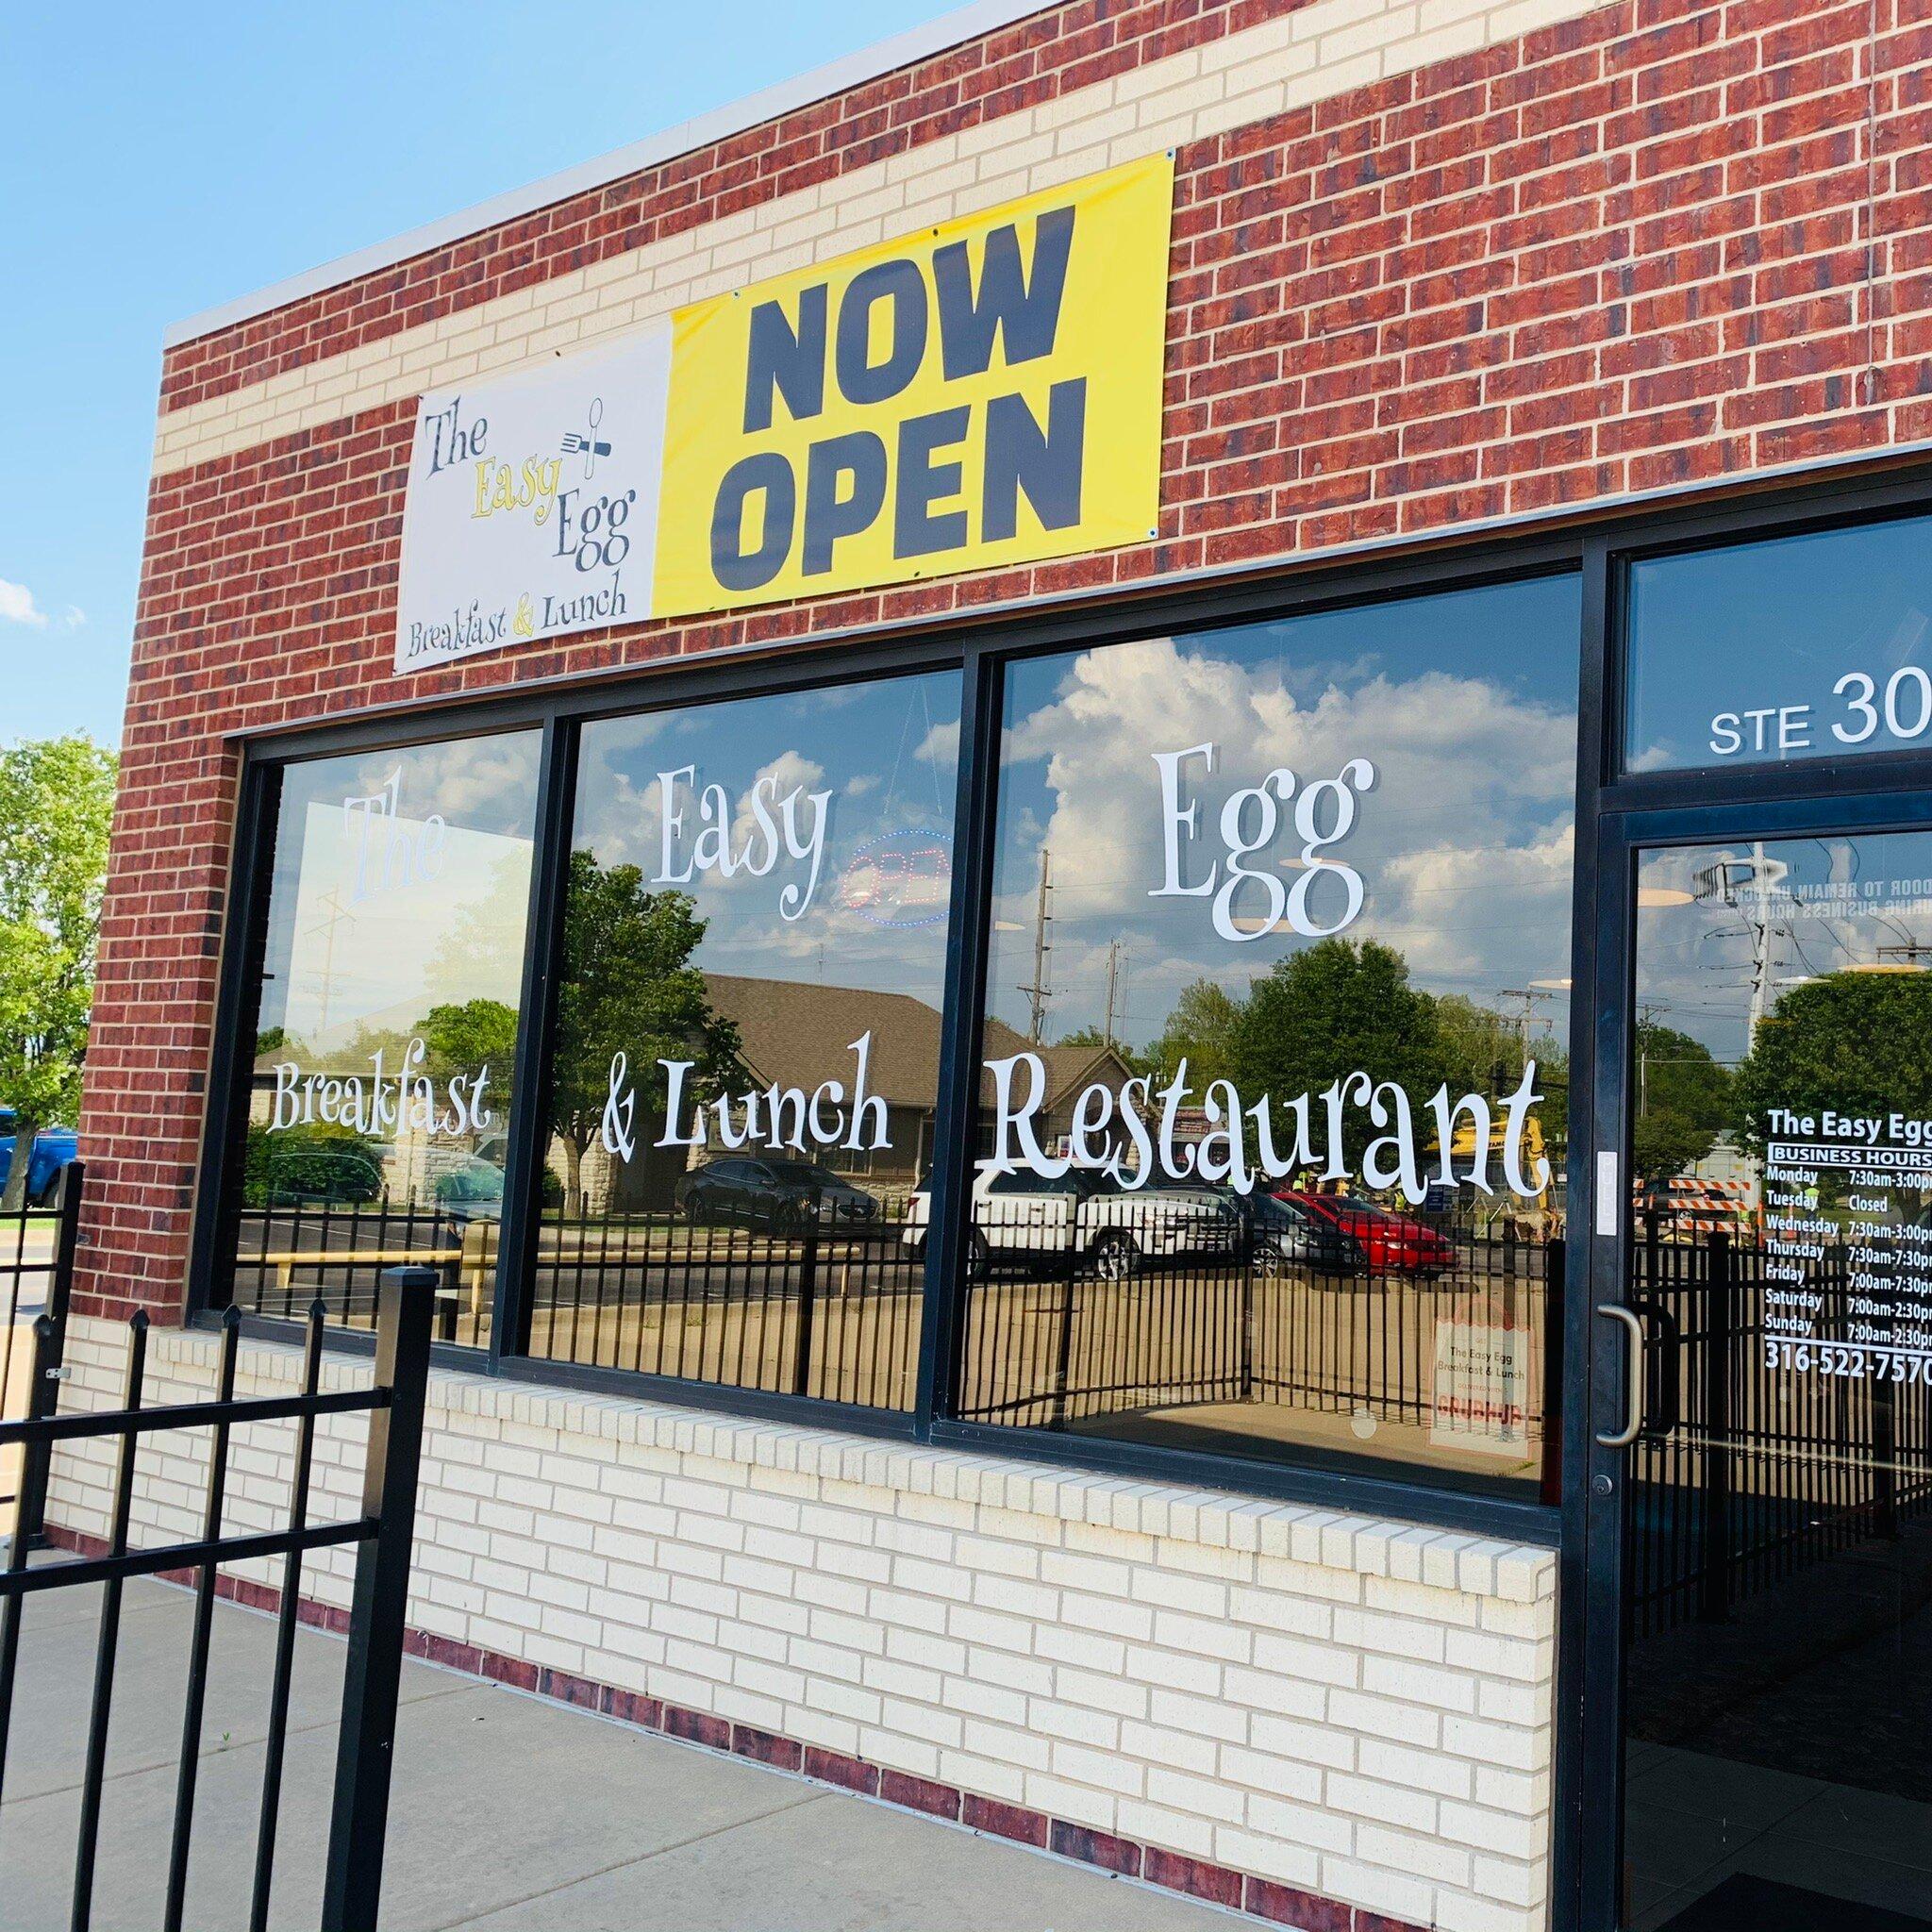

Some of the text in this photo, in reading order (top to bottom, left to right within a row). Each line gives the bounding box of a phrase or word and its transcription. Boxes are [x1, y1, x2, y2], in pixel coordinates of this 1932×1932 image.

[742, 204, 1076, 434] NOW
[425, 393, 488, 480] The
[471, 451, 561, 526] Easy
[709, 375, 1087, 592] OPEN
[551, 488, 638, 573] Egg
[407, 569, 627, 660] Breakfast & Lunch
[1709, 666, 1932, 755] STE 30
[342, 741, 1375, 942] The Easy Egg
[265, 1030, 1552, 1206] Breakfast & Lunch Restaurant
[1768, 1108, 1815, 1136] The
[1822, 1111, 1882, 1146] Easy
[1774, 1146, 1932, 1168] BUSINESS HOURS
[1767, 1166, 1818, 1191] Monday
[1766, 1191, 1888, 1216] Tuesday Closed
[1766, 1214, 1839, 1241] Wednesday
[1766, 1239, 1824, 1262] Thursday
[1766, 1264, 1805, 1285] Friday
[1765, 1289, 1823, 1312] Saturday
[1765, 1313, 1813, 1336] Sunday
[1438, 1360, 1483, 1375] Breakfast
[1496, 1369, 1525, 1381] Lunch
[1450, 1346, 1512, 1365] The Easy Egg
